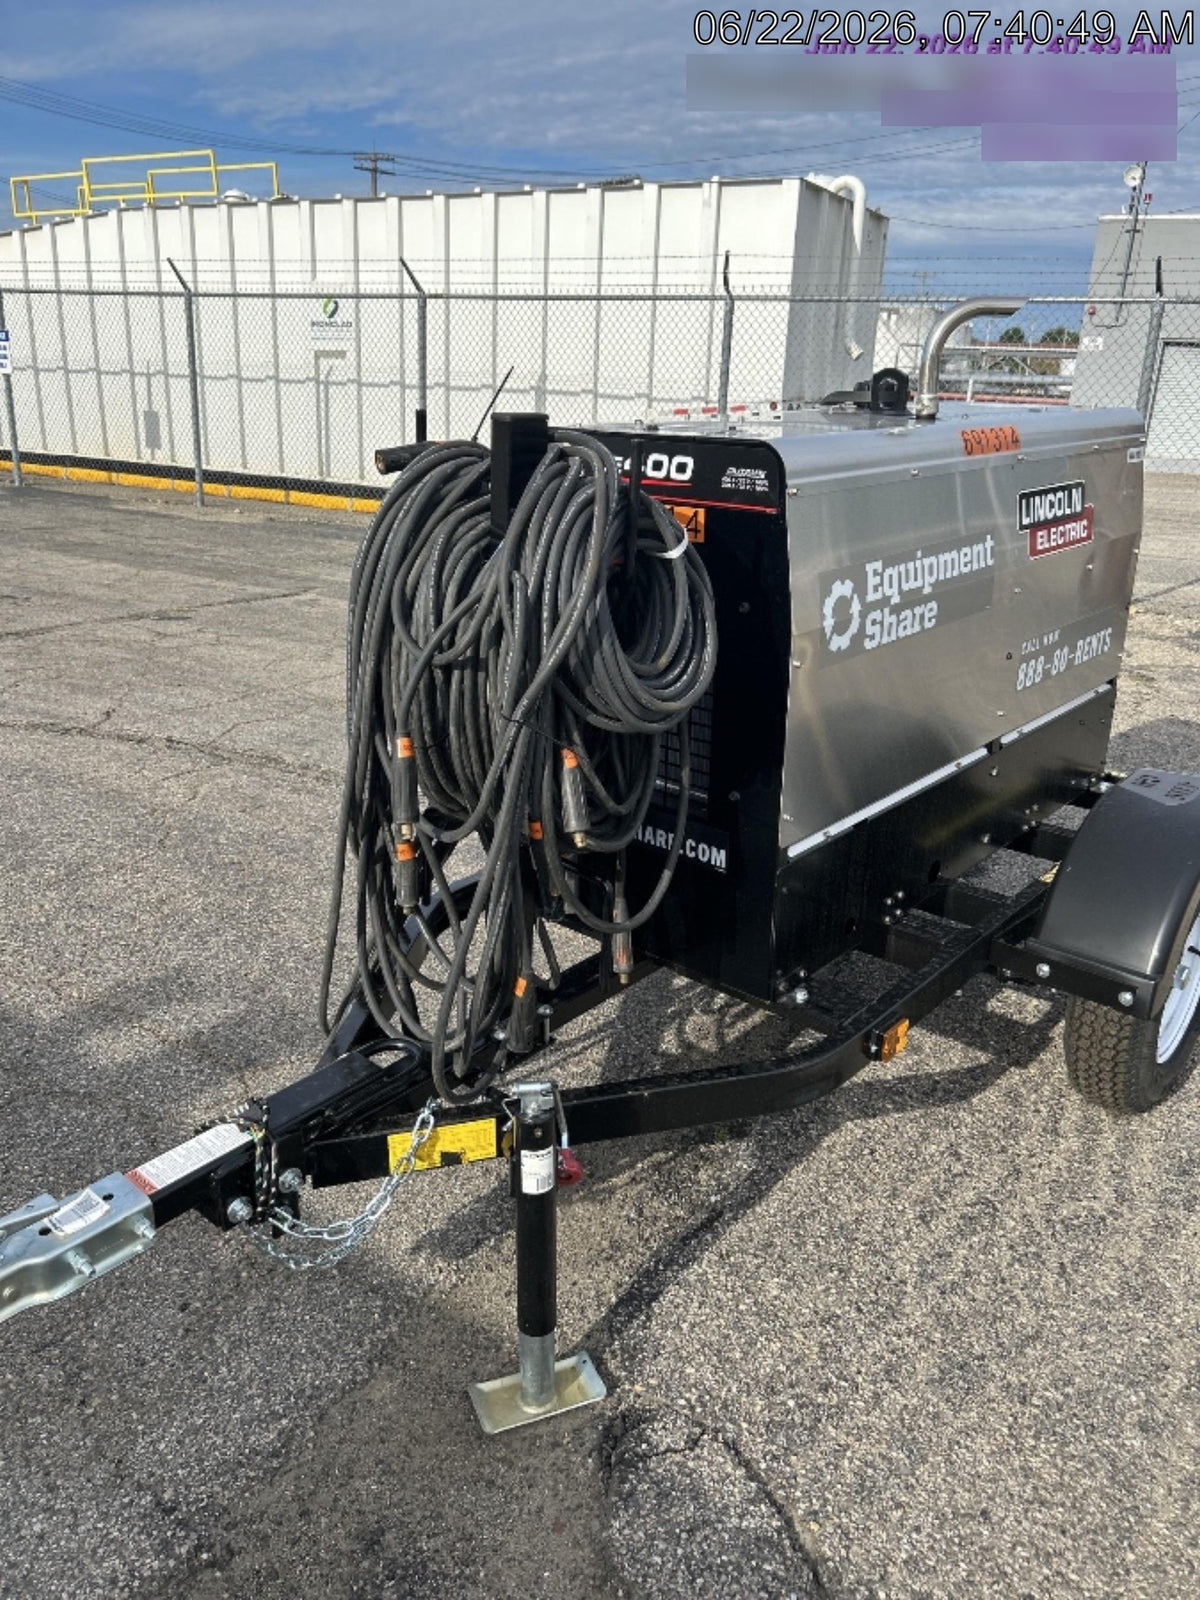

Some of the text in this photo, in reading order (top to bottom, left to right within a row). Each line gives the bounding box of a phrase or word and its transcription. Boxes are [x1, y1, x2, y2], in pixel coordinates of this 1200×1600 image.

[961, 425, 1019, 455] 691314
[1022, 486, 1082, 525] LINCOLN
[1036, 519, 1088, 550] ELECTRIC
[865, 534, 995, 605] Equipment
[864, 601, 938, 650] Share
[1016, 627, 1112, 691] 888-80-RENTS
